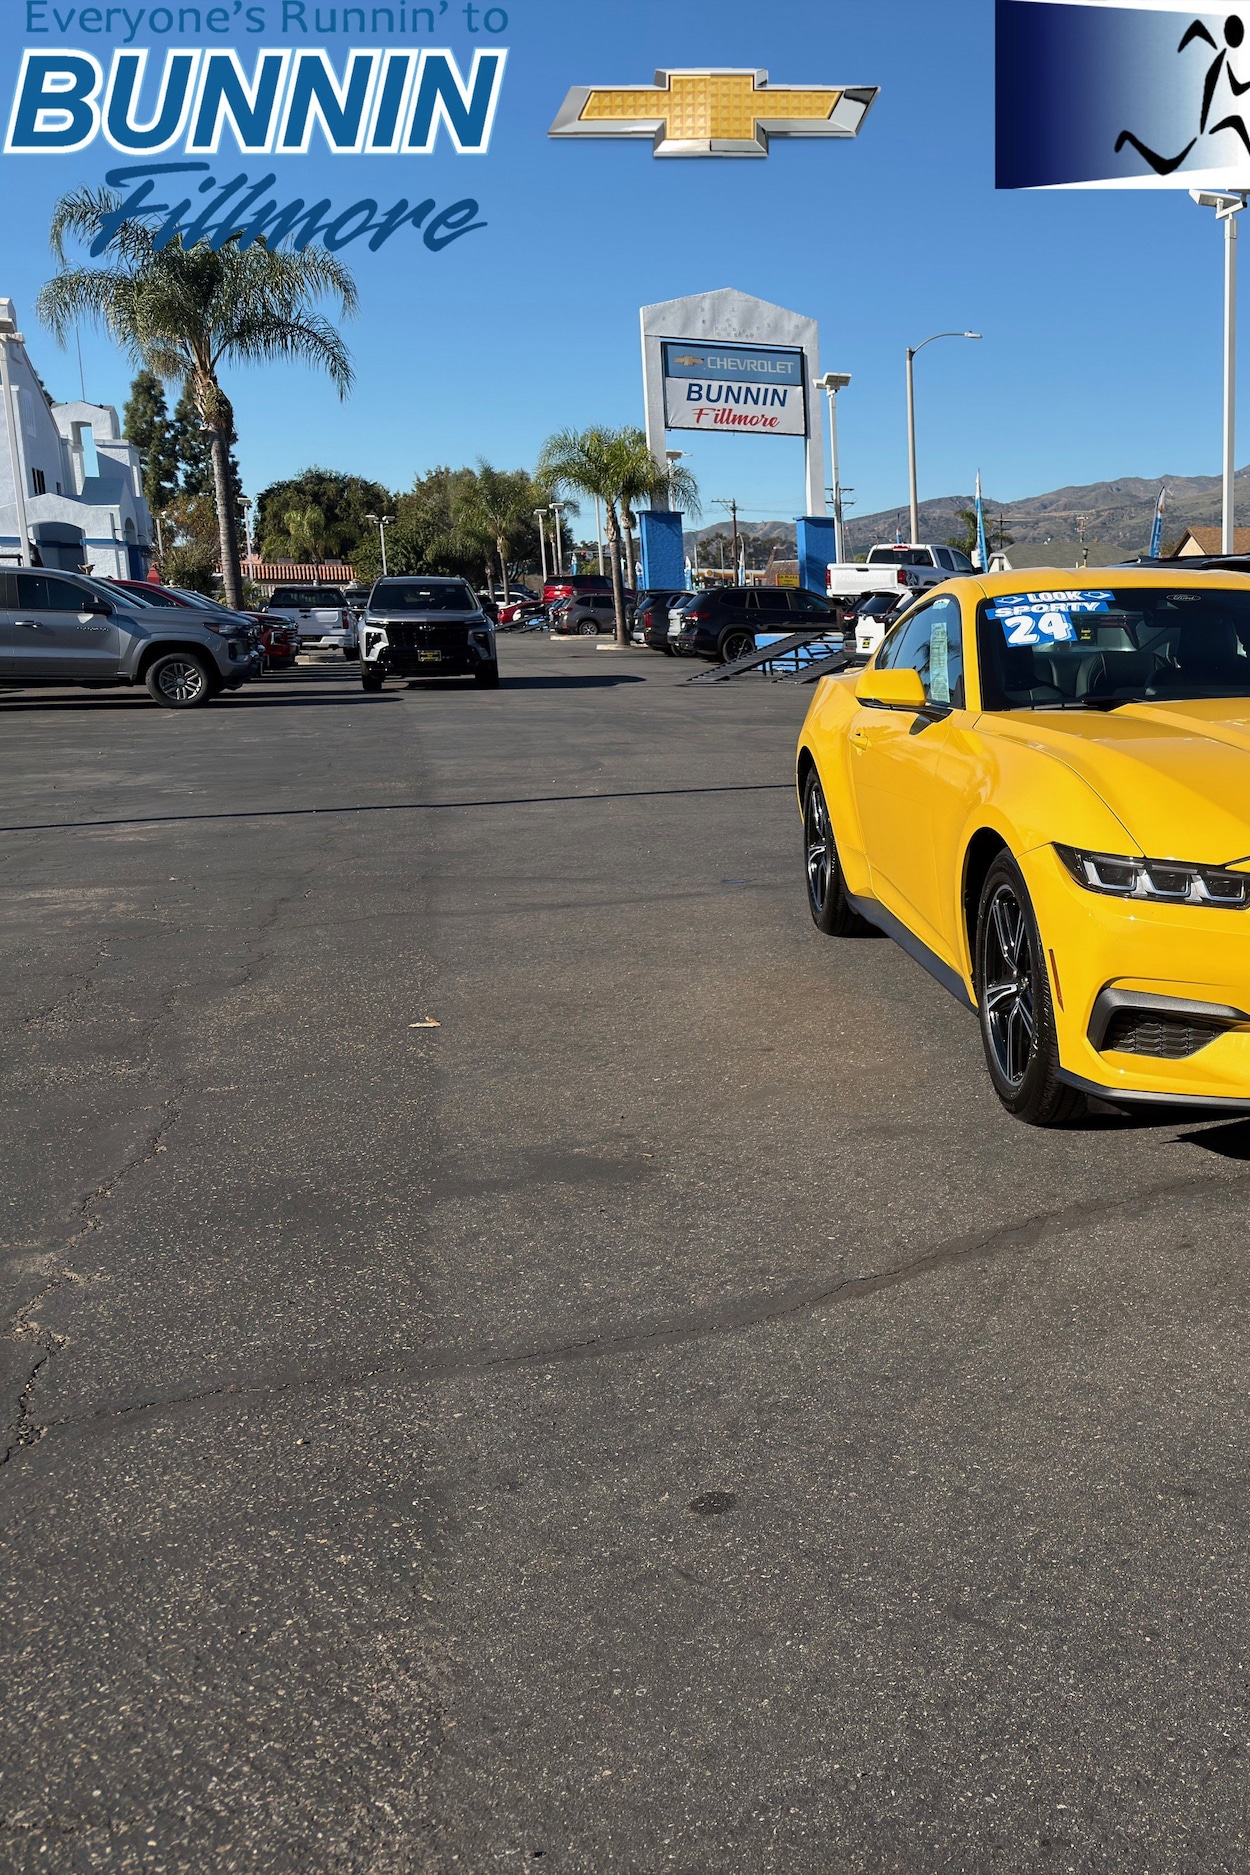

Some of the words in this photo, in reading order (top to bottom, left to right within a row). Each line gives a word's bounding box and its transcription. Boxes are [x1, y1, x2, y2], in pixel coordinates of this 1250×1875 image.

[707, 356, 795, 374] CHEVROLET
[686, 383, 788, 408] BUNNIN
[692, 407, 781, 428] Fillmore
[1027, 591, 1085, 603] LOOK
[994, 601, 1100, 618] SPORTY
[1004, 612, 1073, 644] 24
